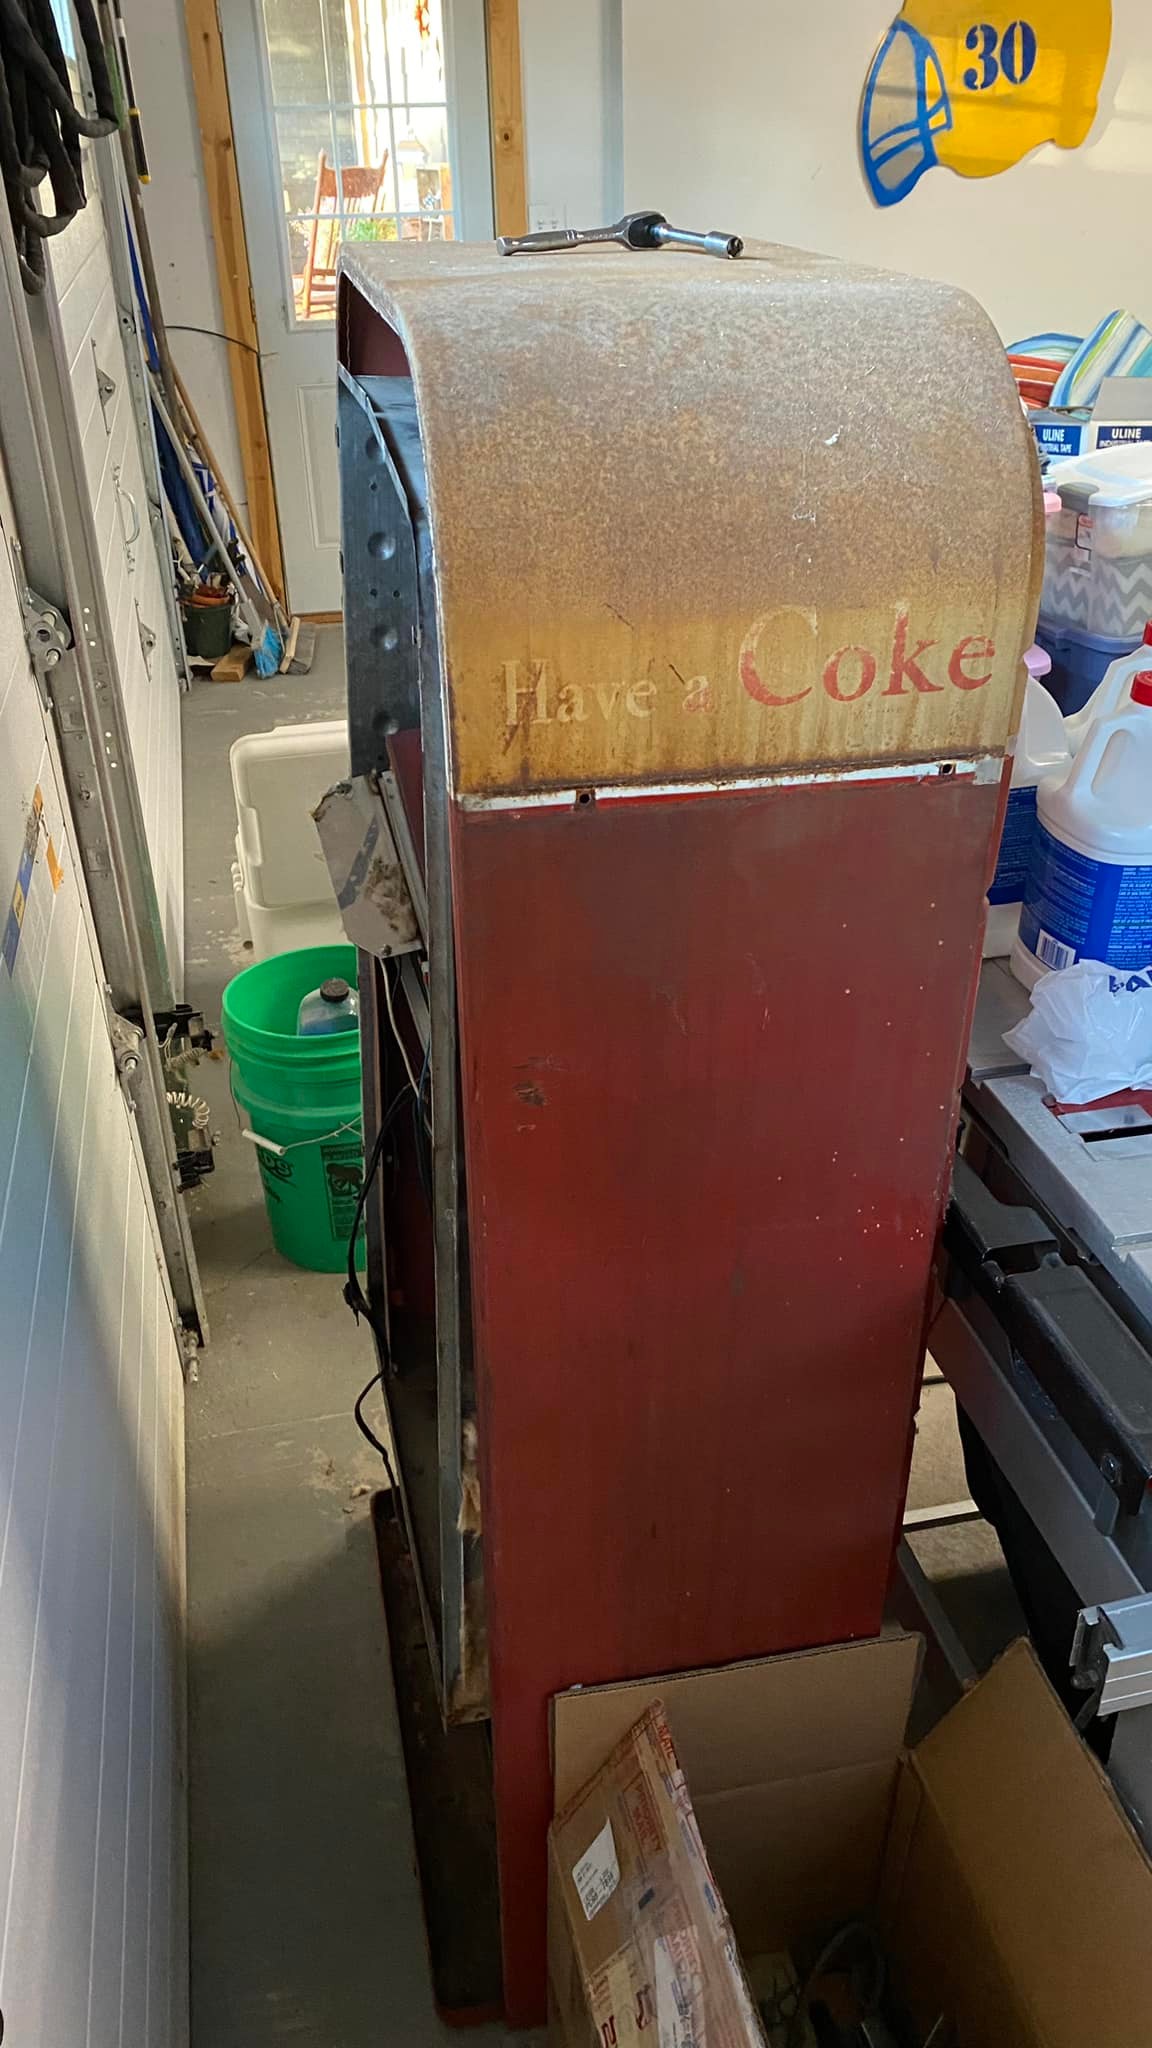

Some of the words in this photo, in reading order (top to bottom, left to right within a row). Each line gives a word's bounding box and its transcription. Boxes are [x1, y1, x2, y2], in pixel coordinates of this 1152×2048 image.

[963, 20, 1037, 90] 30
[1042, 428, 1065, 442] ULINE
[1112, 428, 1141, 439] ULINE
[1060, 443, 1072, 453] TAPE
[501, 656, 658, 726] Have
[683, 674, 715, 713] a
[739, 600, 995, 707] Coke
